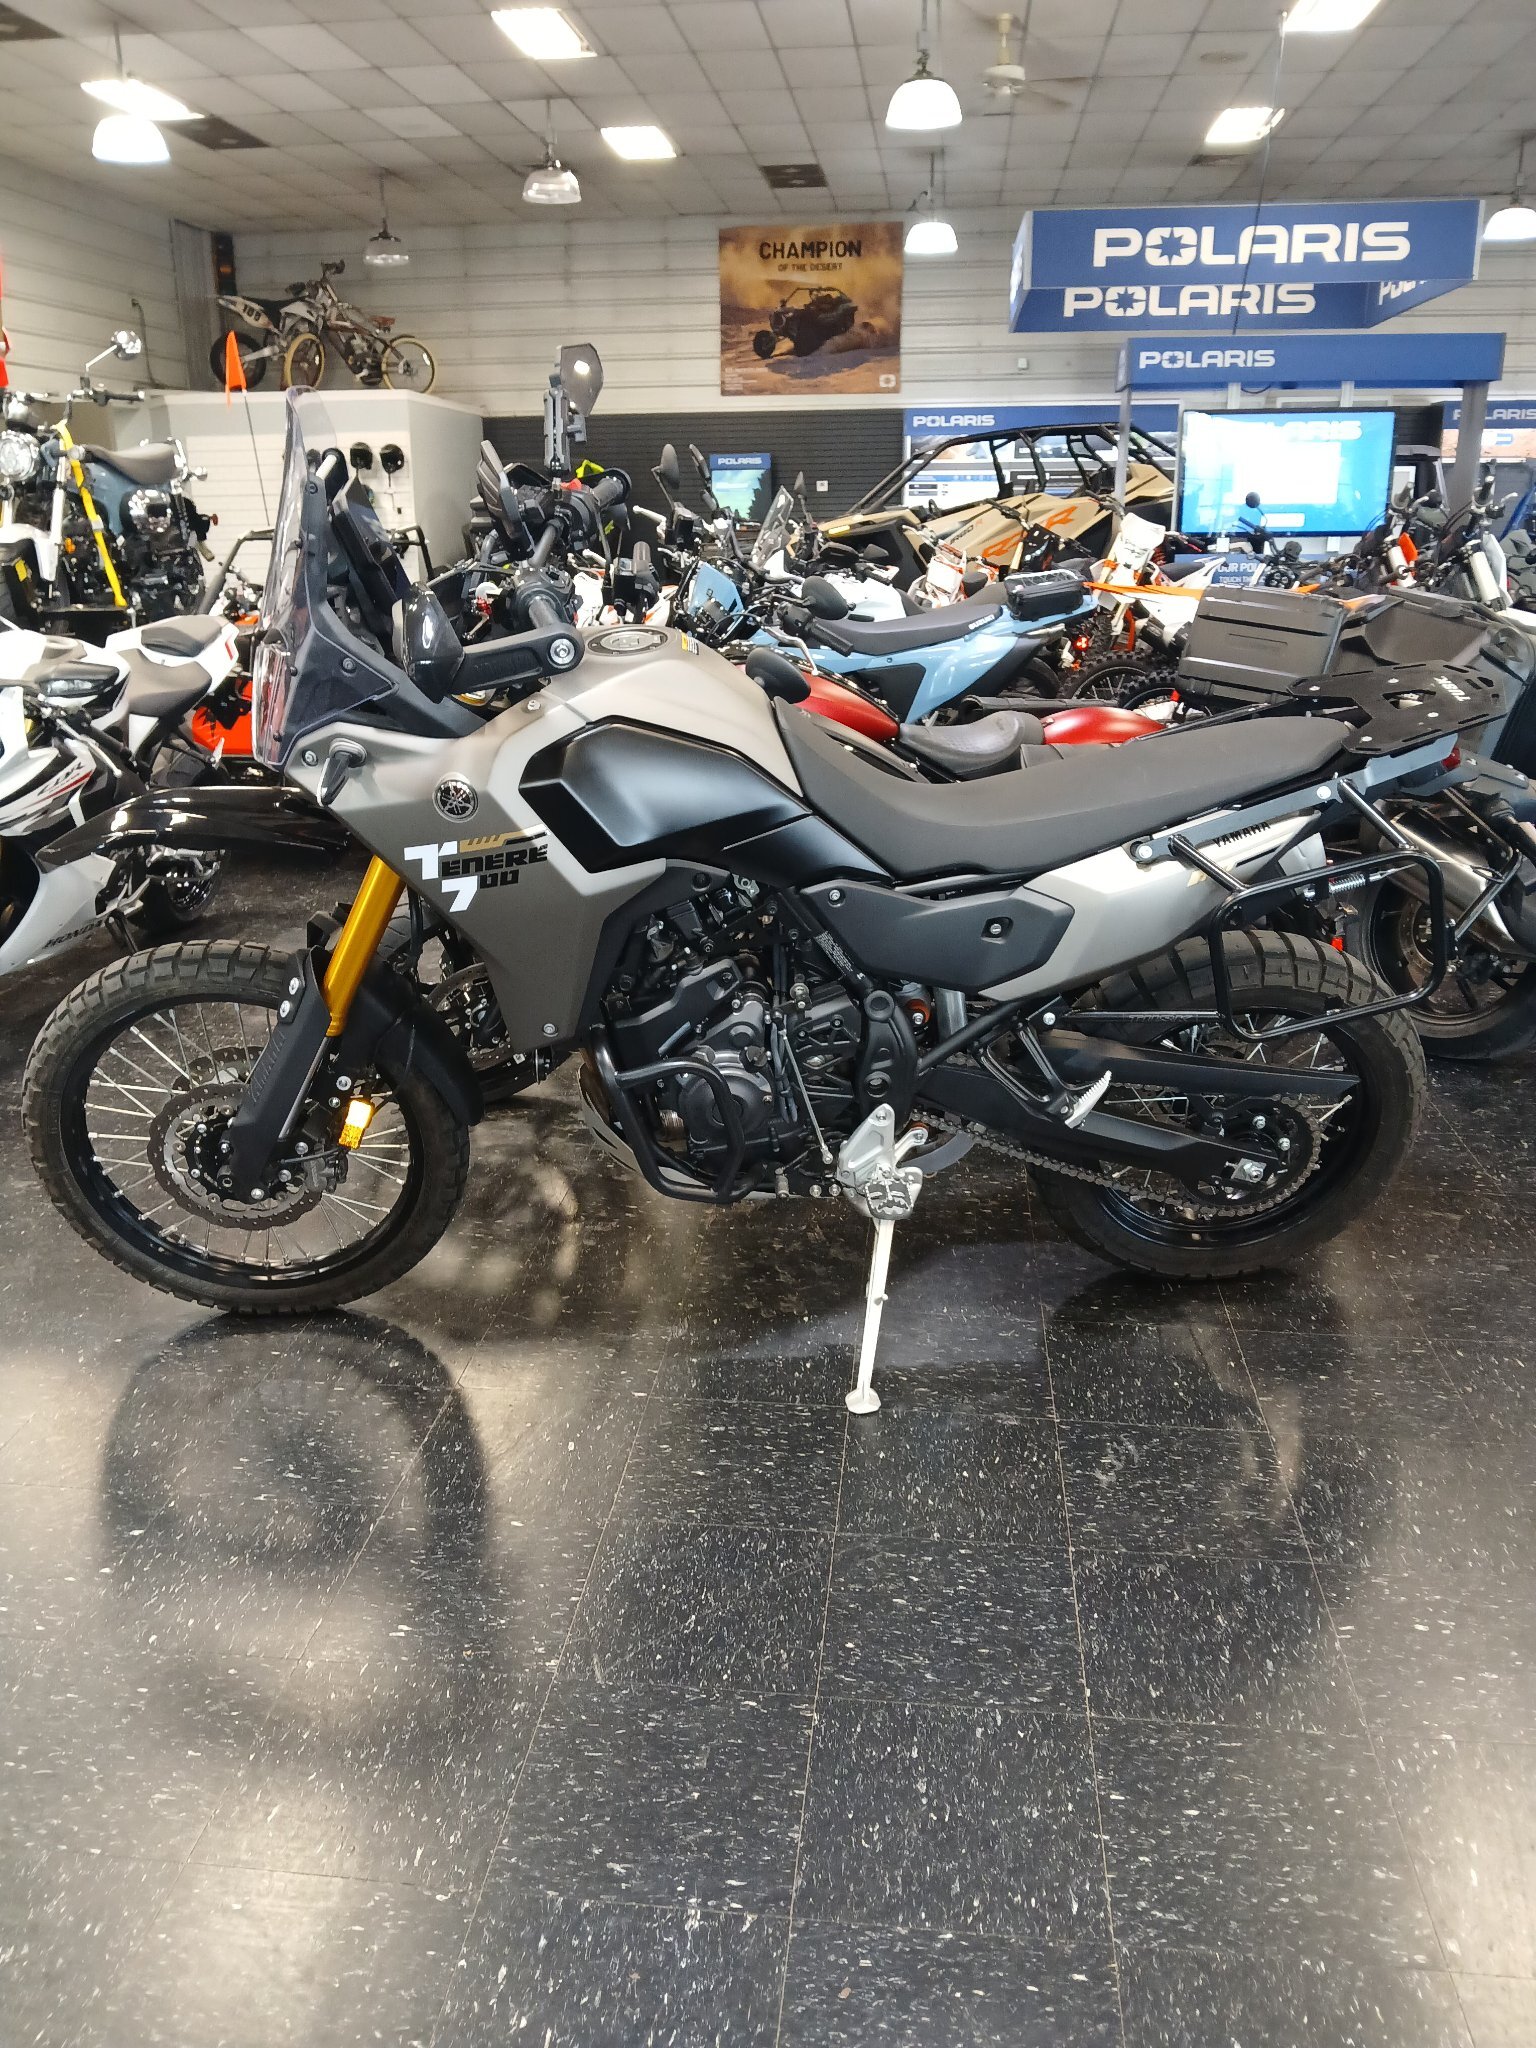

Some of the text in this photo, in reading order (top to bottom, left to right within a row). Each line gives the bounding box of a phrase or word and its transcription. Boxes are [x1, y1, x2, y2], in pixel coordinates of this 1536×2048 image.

[759, 240, 862, 260] CHAMPION
[1092, 221, 1411, 268] POLARIS
[778, 263, 843, 272] OF THE DESERT
[1063, 284, 1317, 318] POLARIS
[1139, 350, 1276, 369] POLARIS
[912, 414, 996, 428] POLARIS
[1452, 408, 1536, 420] PARIS
[1212, 821, 1271, 848] YAMAHA
[441, 869, 520, 913] 700
